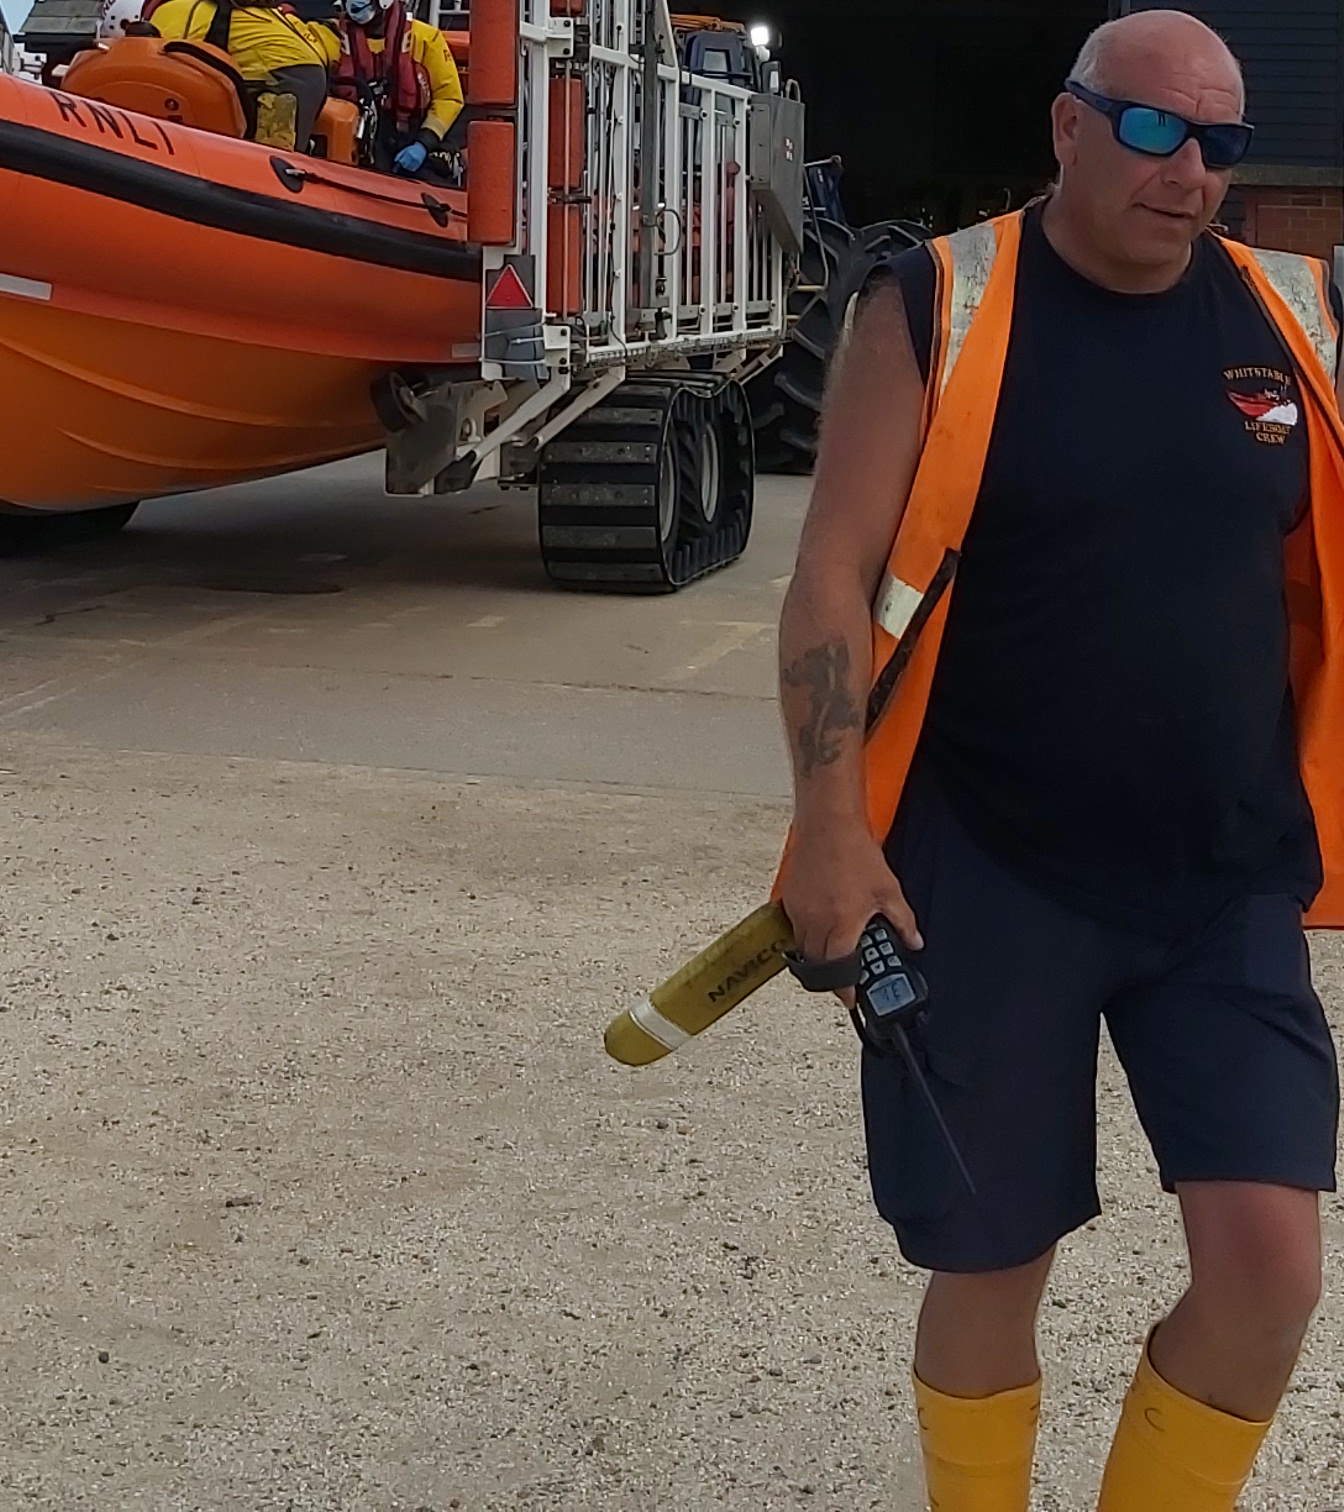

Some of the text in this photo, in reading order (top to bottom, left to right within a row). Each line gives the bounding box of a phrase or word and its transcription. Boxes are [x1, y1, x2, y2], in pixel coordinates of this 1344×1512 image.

[45, 88, 175, 155] RNLI
[1223, 368, 1291, 386] WHITSTABLE
[1244, 421, 1291, 435] LIFEBOAT
[1256, 432, 1286, 444] CREW
[708, 939, 787, 1002] NAVICO
